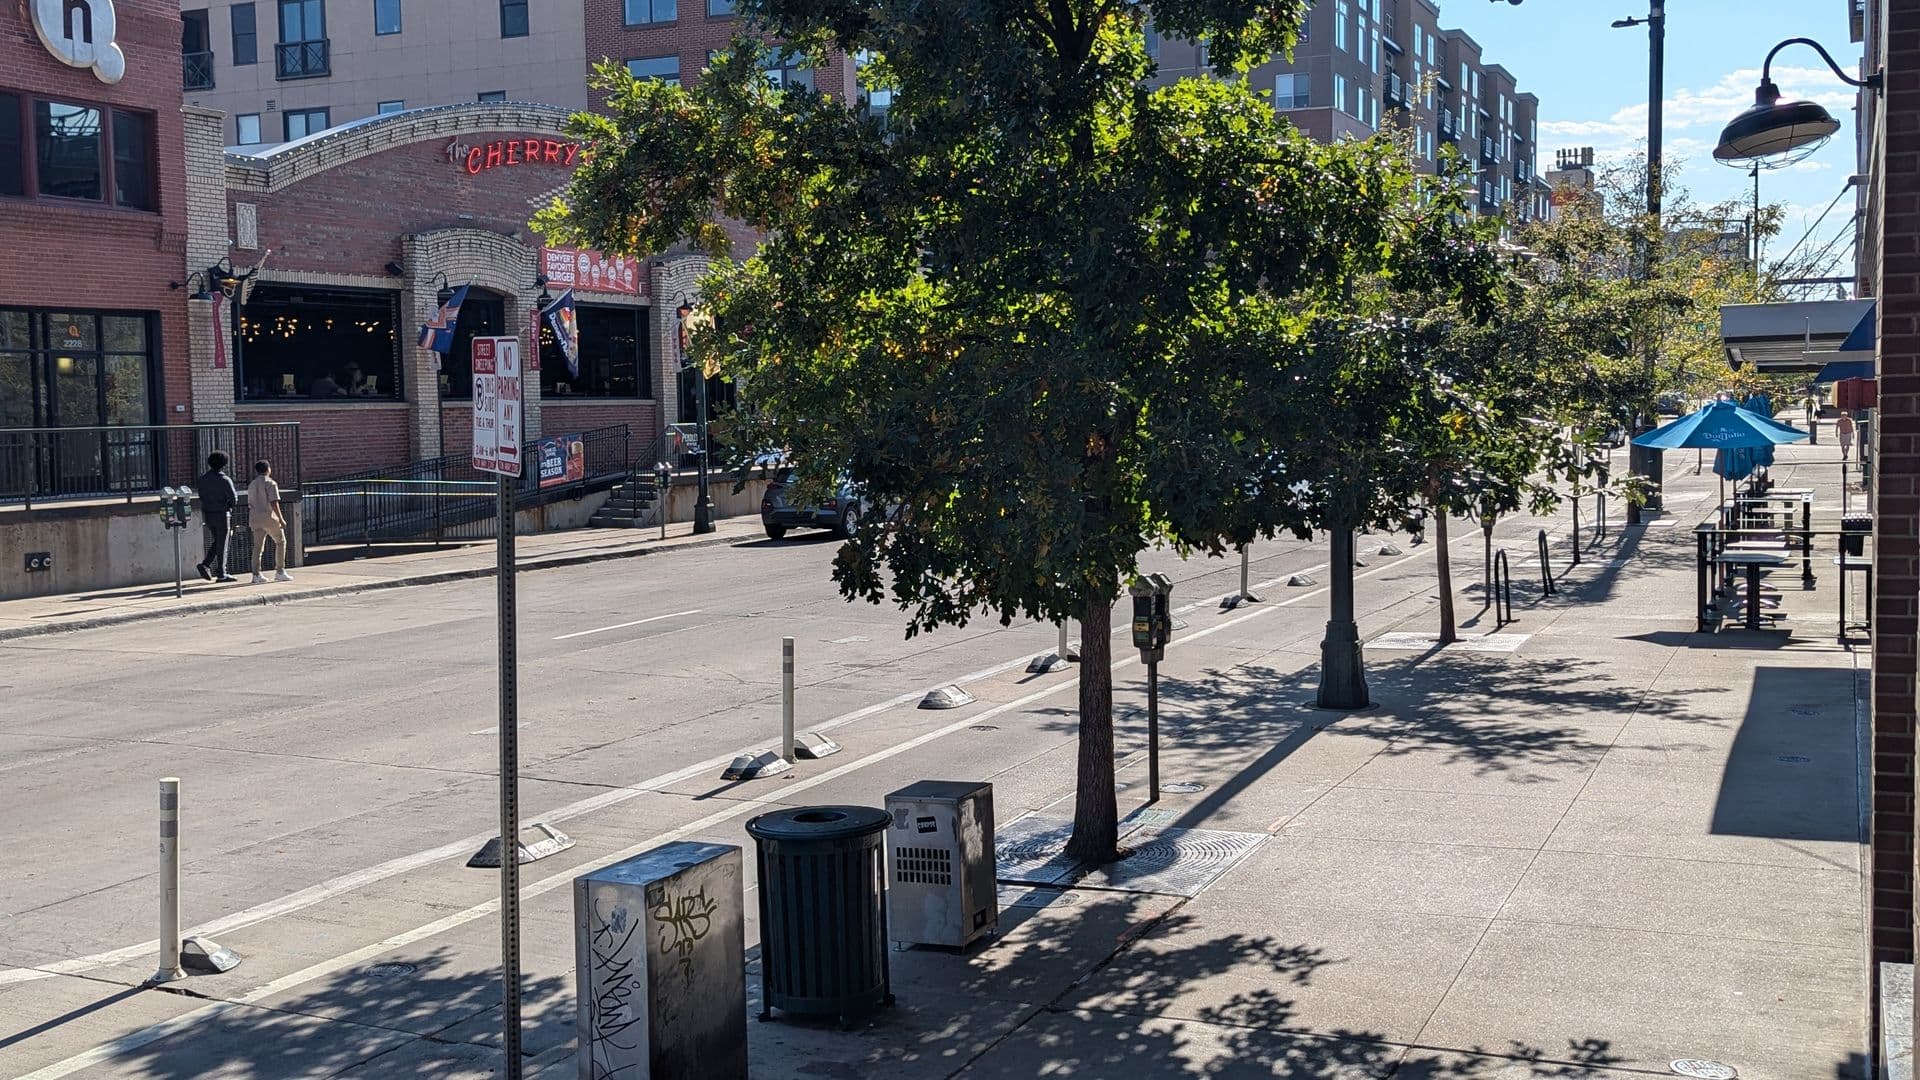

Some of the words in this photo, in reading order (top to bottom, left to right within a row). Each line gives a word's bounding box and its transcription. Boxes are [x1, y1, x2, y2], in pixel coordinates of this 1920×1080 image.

[446, 137, 469, 163] The
[467, 140, 580, 174] CHERRY
[546, 253, 575, 264] DENVER'S
[546, 262, 575, 272] FAVORITE
[547, 271, 575, 282] BURGER
[63, 339, 82, 348] 2228
[477, 343, 490, 356] STREET
[503, 345, 512, 370] NO
[475, 358, 494, 371] SWEEPING
[484, 377, 495, 394] THIS
[497, 376, 519, 401] PARKING
[484, 396, 495, 412] SIDE
[503, 404, 513, 421] ANY
[503, 424, 514, 442] TIME
[546, 457, 562, 468] BEER
[540, 466, 563, 478] SEASON
